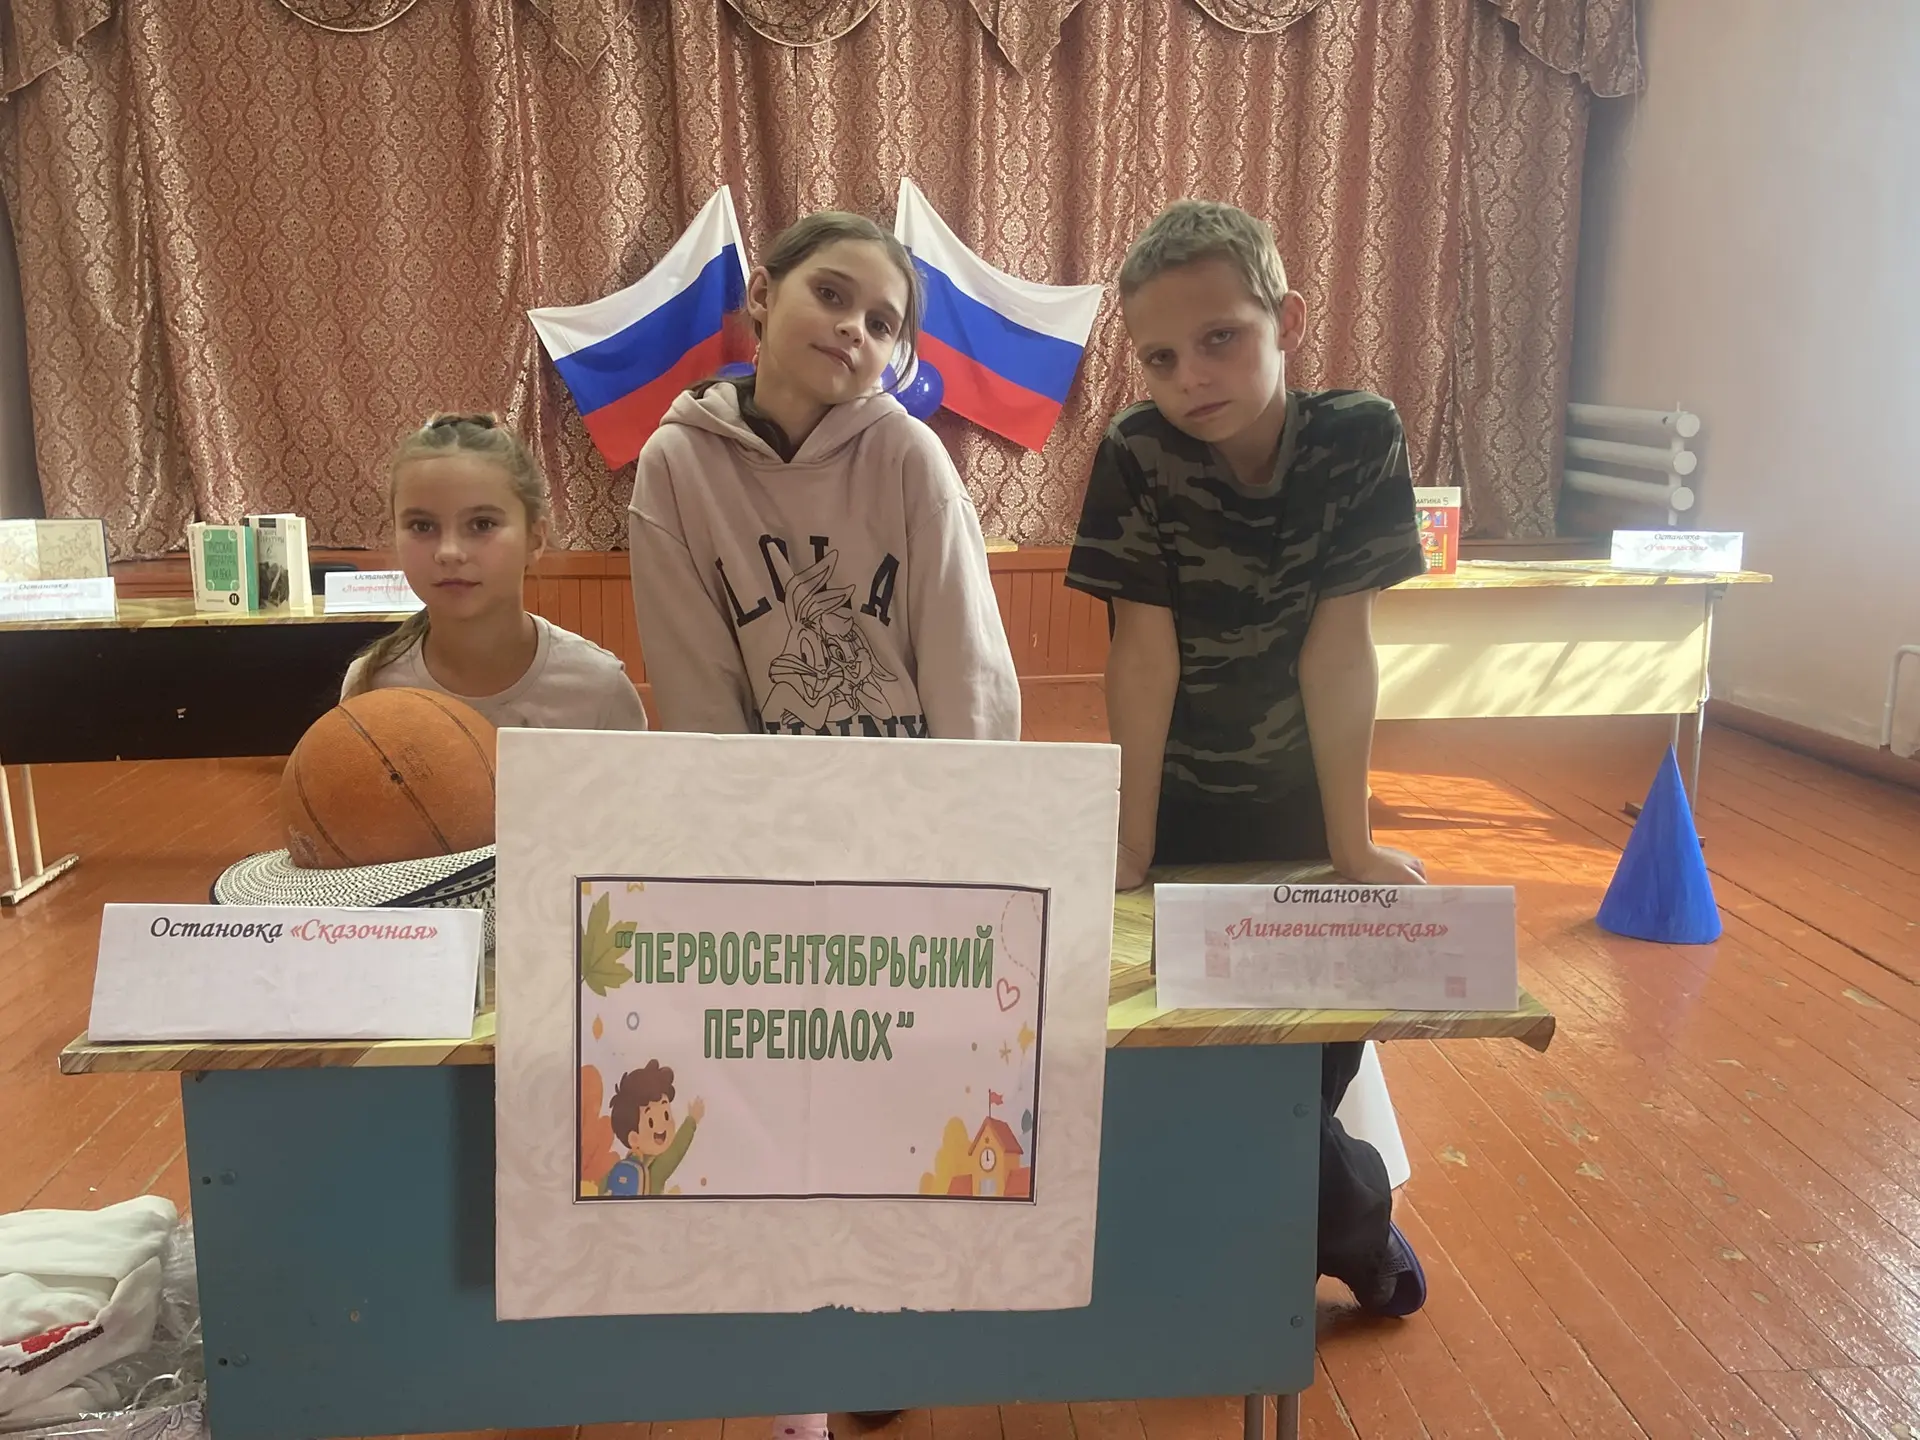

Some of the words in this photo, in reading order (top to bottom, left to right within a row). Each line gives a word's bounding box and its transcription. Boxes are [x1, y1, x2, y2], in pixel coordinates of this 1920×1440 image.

[1654, 533, 1700, 541] Остановка
[354, 573, 400, 582] Остановка
[1273, 885, 1399, 908] Остановка
[150, 916, 283, 943] Остановка
[290, 918, 438, 944] «Сказочная»
[1225, 917, 1449, 943] «Лингвистическая»
